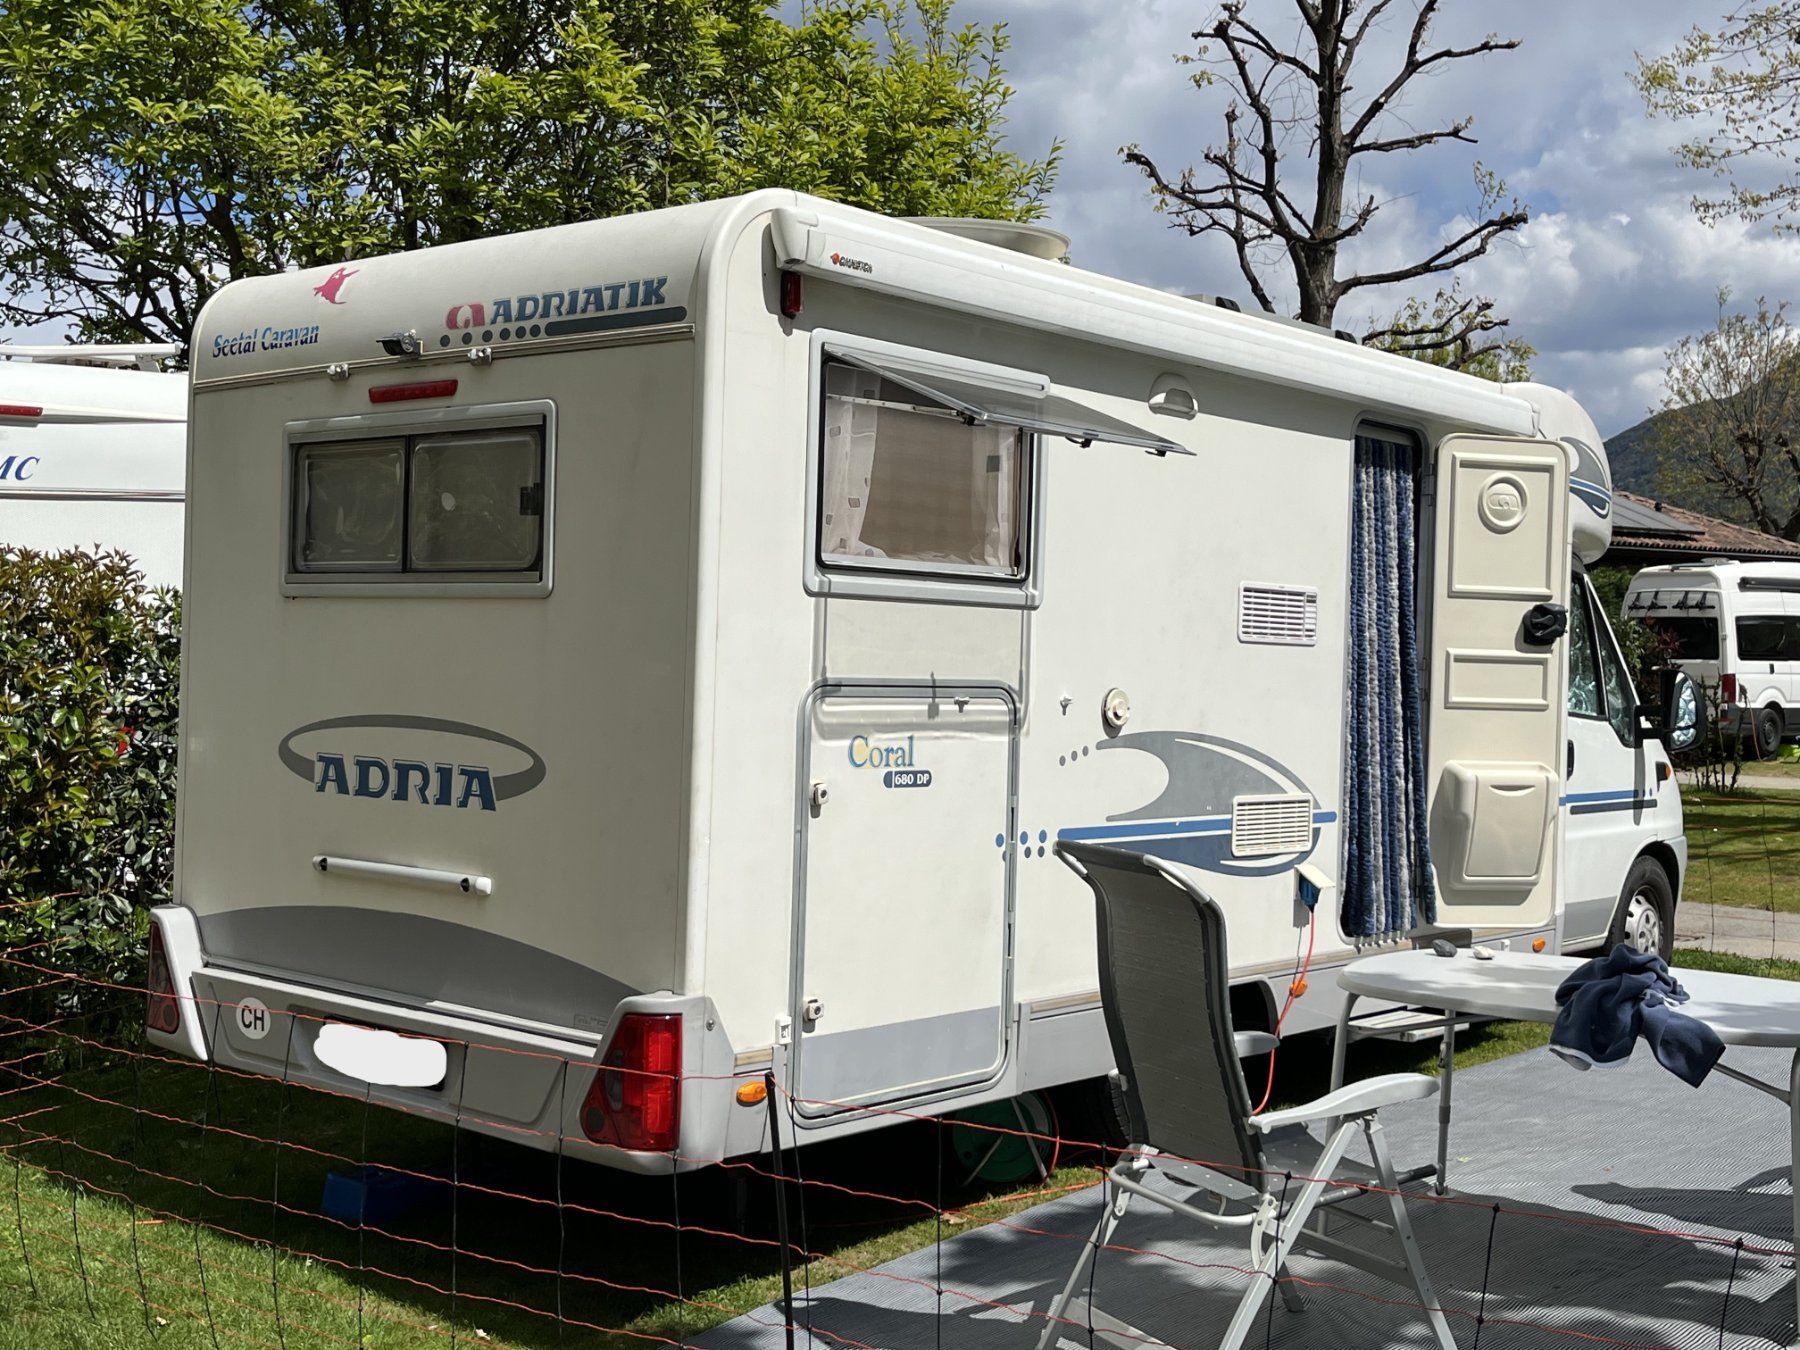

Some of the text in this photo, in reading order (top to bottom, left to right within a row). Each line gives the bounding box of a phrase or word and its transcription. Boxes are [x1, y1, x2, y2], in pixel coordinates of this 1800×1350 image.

[490, 276, 668, 325] ADRIATIK
[213, 325, 320, 358] Seetal Caravan
[848, 734, 914, 768] Coral
[315, 752, 497, 812] ADRIA
[894, 772, 930, 785] 680 DP
[241, 1004, 265, 1032] CH
